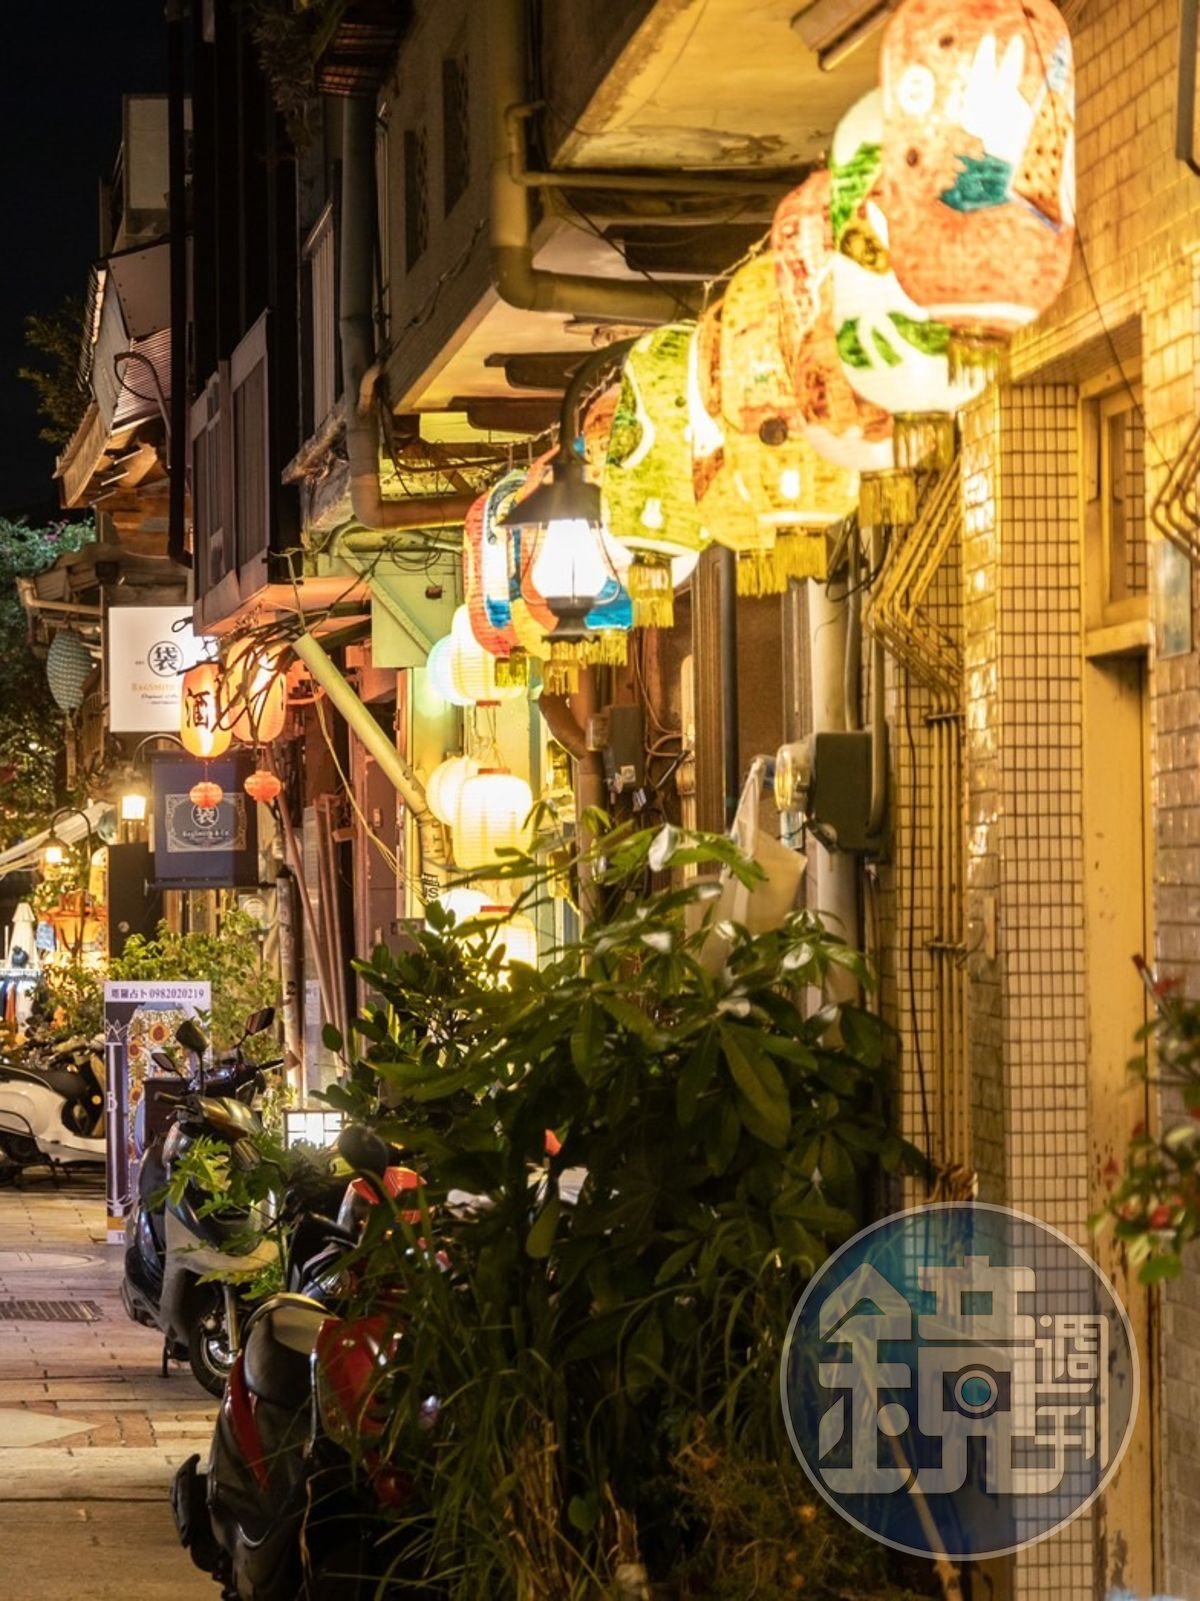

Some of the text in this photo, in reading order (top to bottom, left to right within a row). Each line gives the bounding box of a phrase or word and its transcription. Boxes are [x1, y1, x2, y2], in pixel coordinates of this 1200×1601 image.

[153, 646, 178, 671] 袋
[185, 688, 210, 730] 酒
[149, 988, 205, 999] 0982020219
